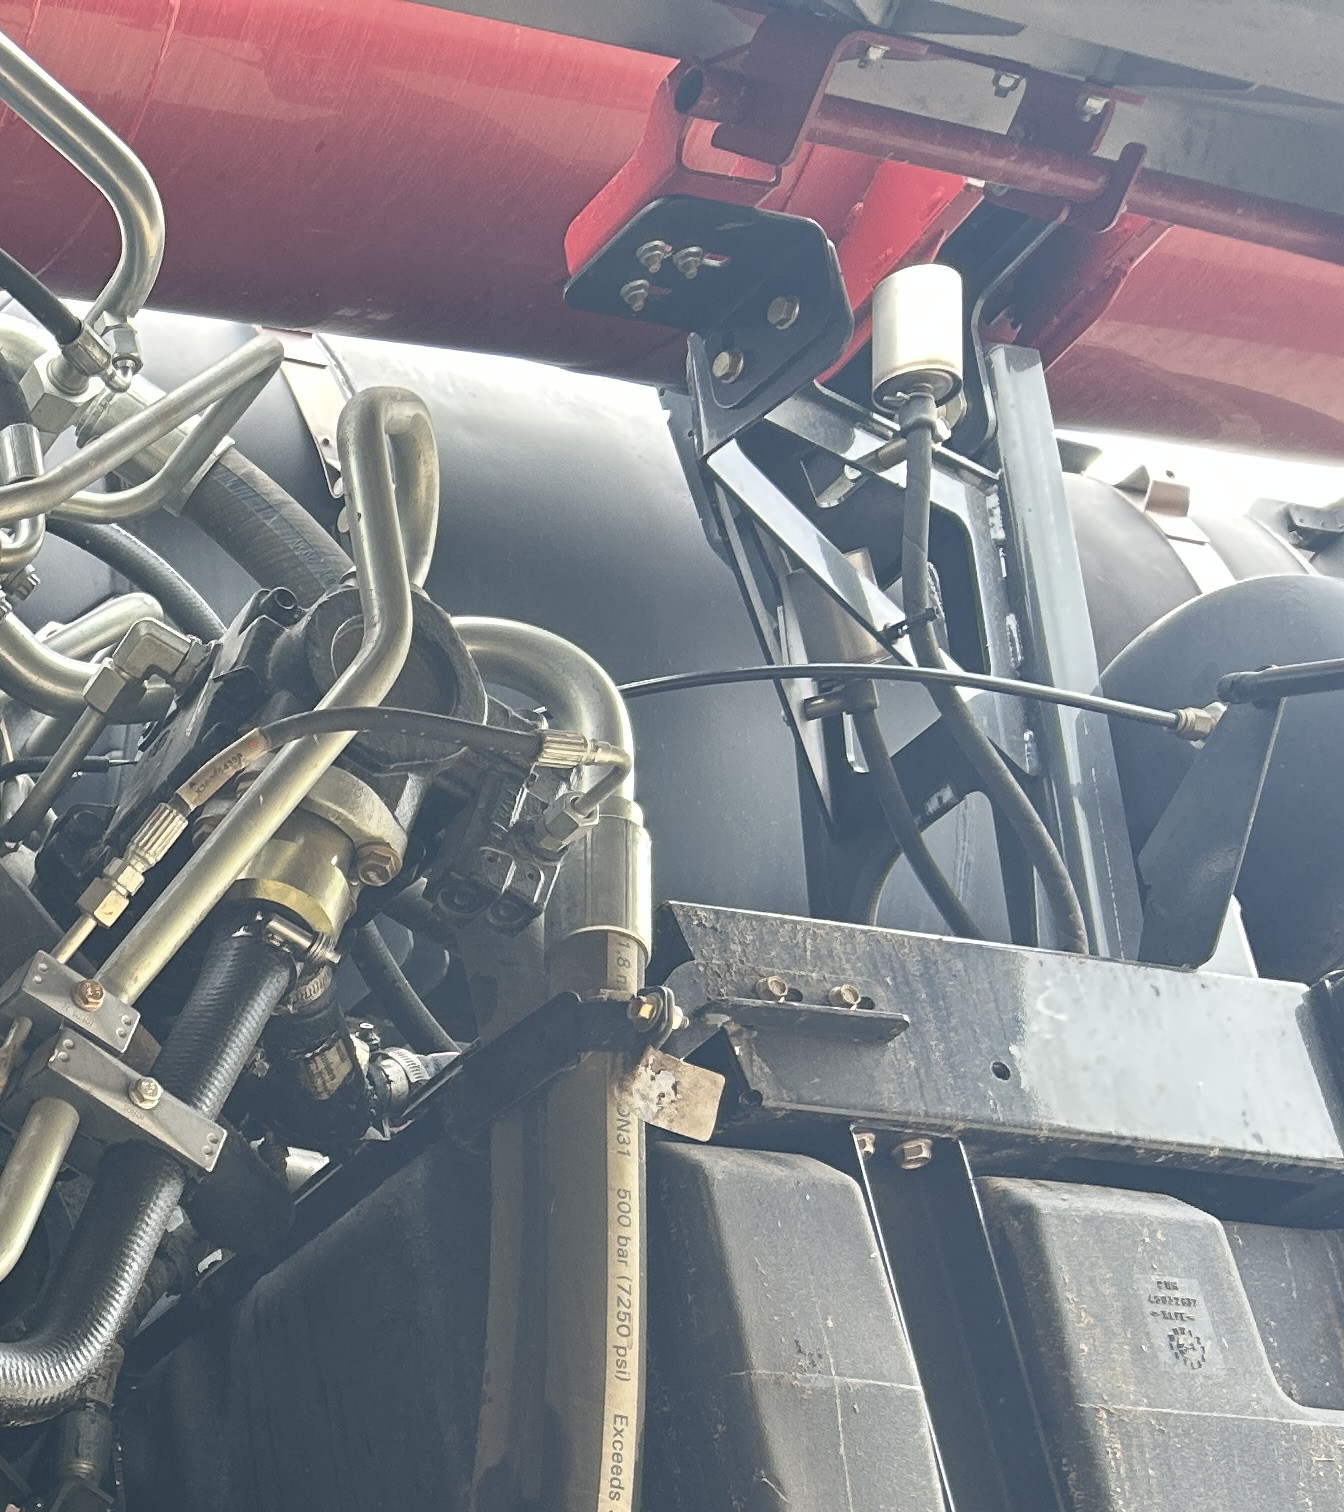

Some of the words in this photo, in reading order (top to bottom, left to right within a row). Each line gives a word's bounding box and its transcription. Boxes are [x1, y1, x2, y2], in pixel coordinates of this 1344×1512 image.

[616, 933, 631, 970] 1.8
[616, 1188, 632, 1229] 500
[616, 1235, 632, 1268] bar
[615, 1275, 633, 1338] (7250
[612, 1344, 633, 1383] psi)
[608, 1413, 629, 1502] Exceeds
